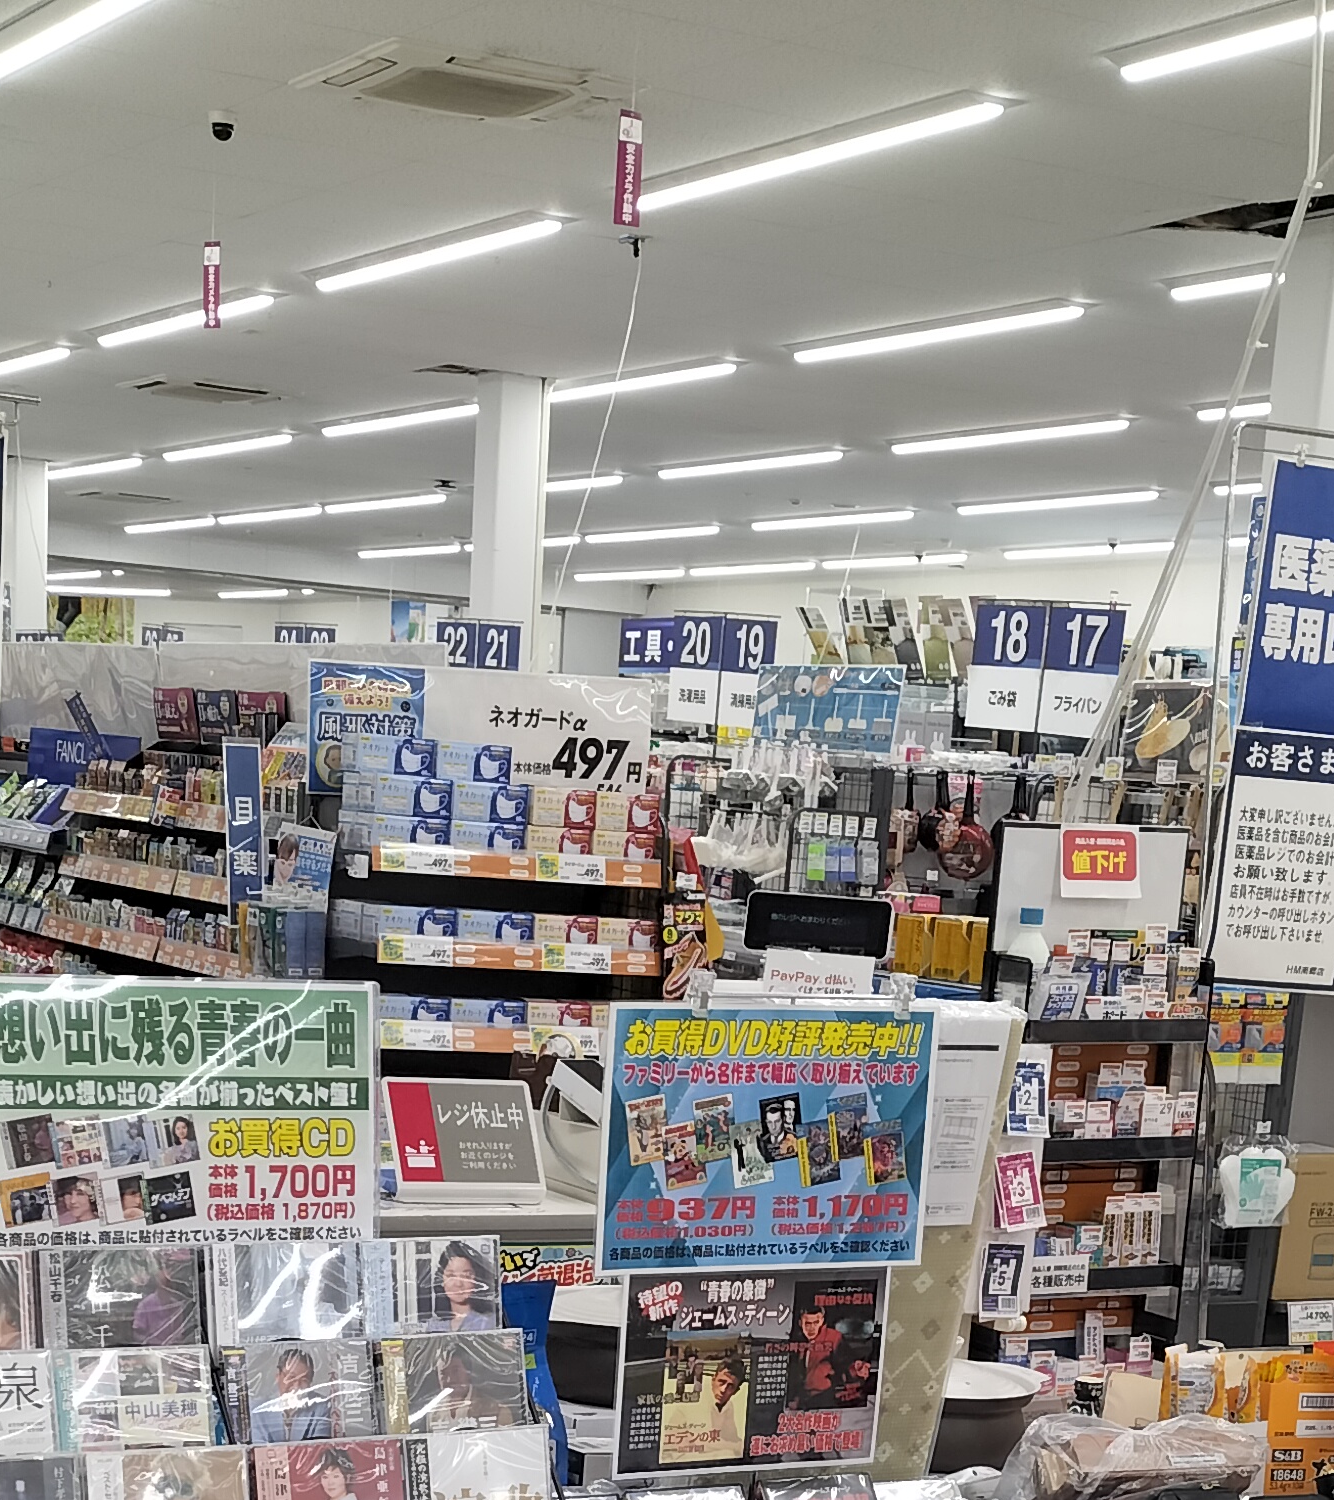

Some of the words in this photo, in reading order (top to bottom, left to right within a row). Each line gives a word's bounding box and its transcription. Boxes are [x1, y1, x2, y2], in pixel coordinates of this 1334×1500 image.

[443, 625, 468, 666] 22
[484, 628, 510, 668] 21
[681, 620, 712, 666] 20
[735, 623, 765, 671] 19
[990, 611, 1029, 664] 18
[1065, 614, 1109, 668] 17
[986, 689, 1018, 709] ごみ袋
[1052, 694, 1103, 716] フライパン
[317, 711, 418, 743] 風邪対策
[489, 705, 589, 733] ネオガードα
[55, 739, 87, 765] FANCL
[513, 761, 552, 776] 本体価格
[551, 736, 643, 784] 497円
[1072, 849, 1128, 875] 値下げ
[623, 1018, 924, 1058] お買得DVD好評発売中!!
[623, 1061, 920, 1087] ファミリーから名作まで幅広く取り揃えています
[436, 1101, 524, 1130] レジ休止中
[208, 1117, 355, 1158] お買得CD
[208, 1164, 239, 1180] 本体
[243, 1164, 356, 1203] 1,700円
[208, 1183, 238, 1199] 価格
[646, 1195, 756, 1222] 937円
[803, 1193, 909, 1221] 1,170円
[638, 1280, 683, 1308] 待望の
[1031, 1273, 1085, 1289] 各種販売中
[649, 1302, 680, 1321] 新作
[124, 1399, 200, 1420] 中山美穂
[663, 1429, 722, 1446] エデンの東
[1273, 1448, 1304, 1462] S&B
[1271, 1468, 1305, 1482] 18648
